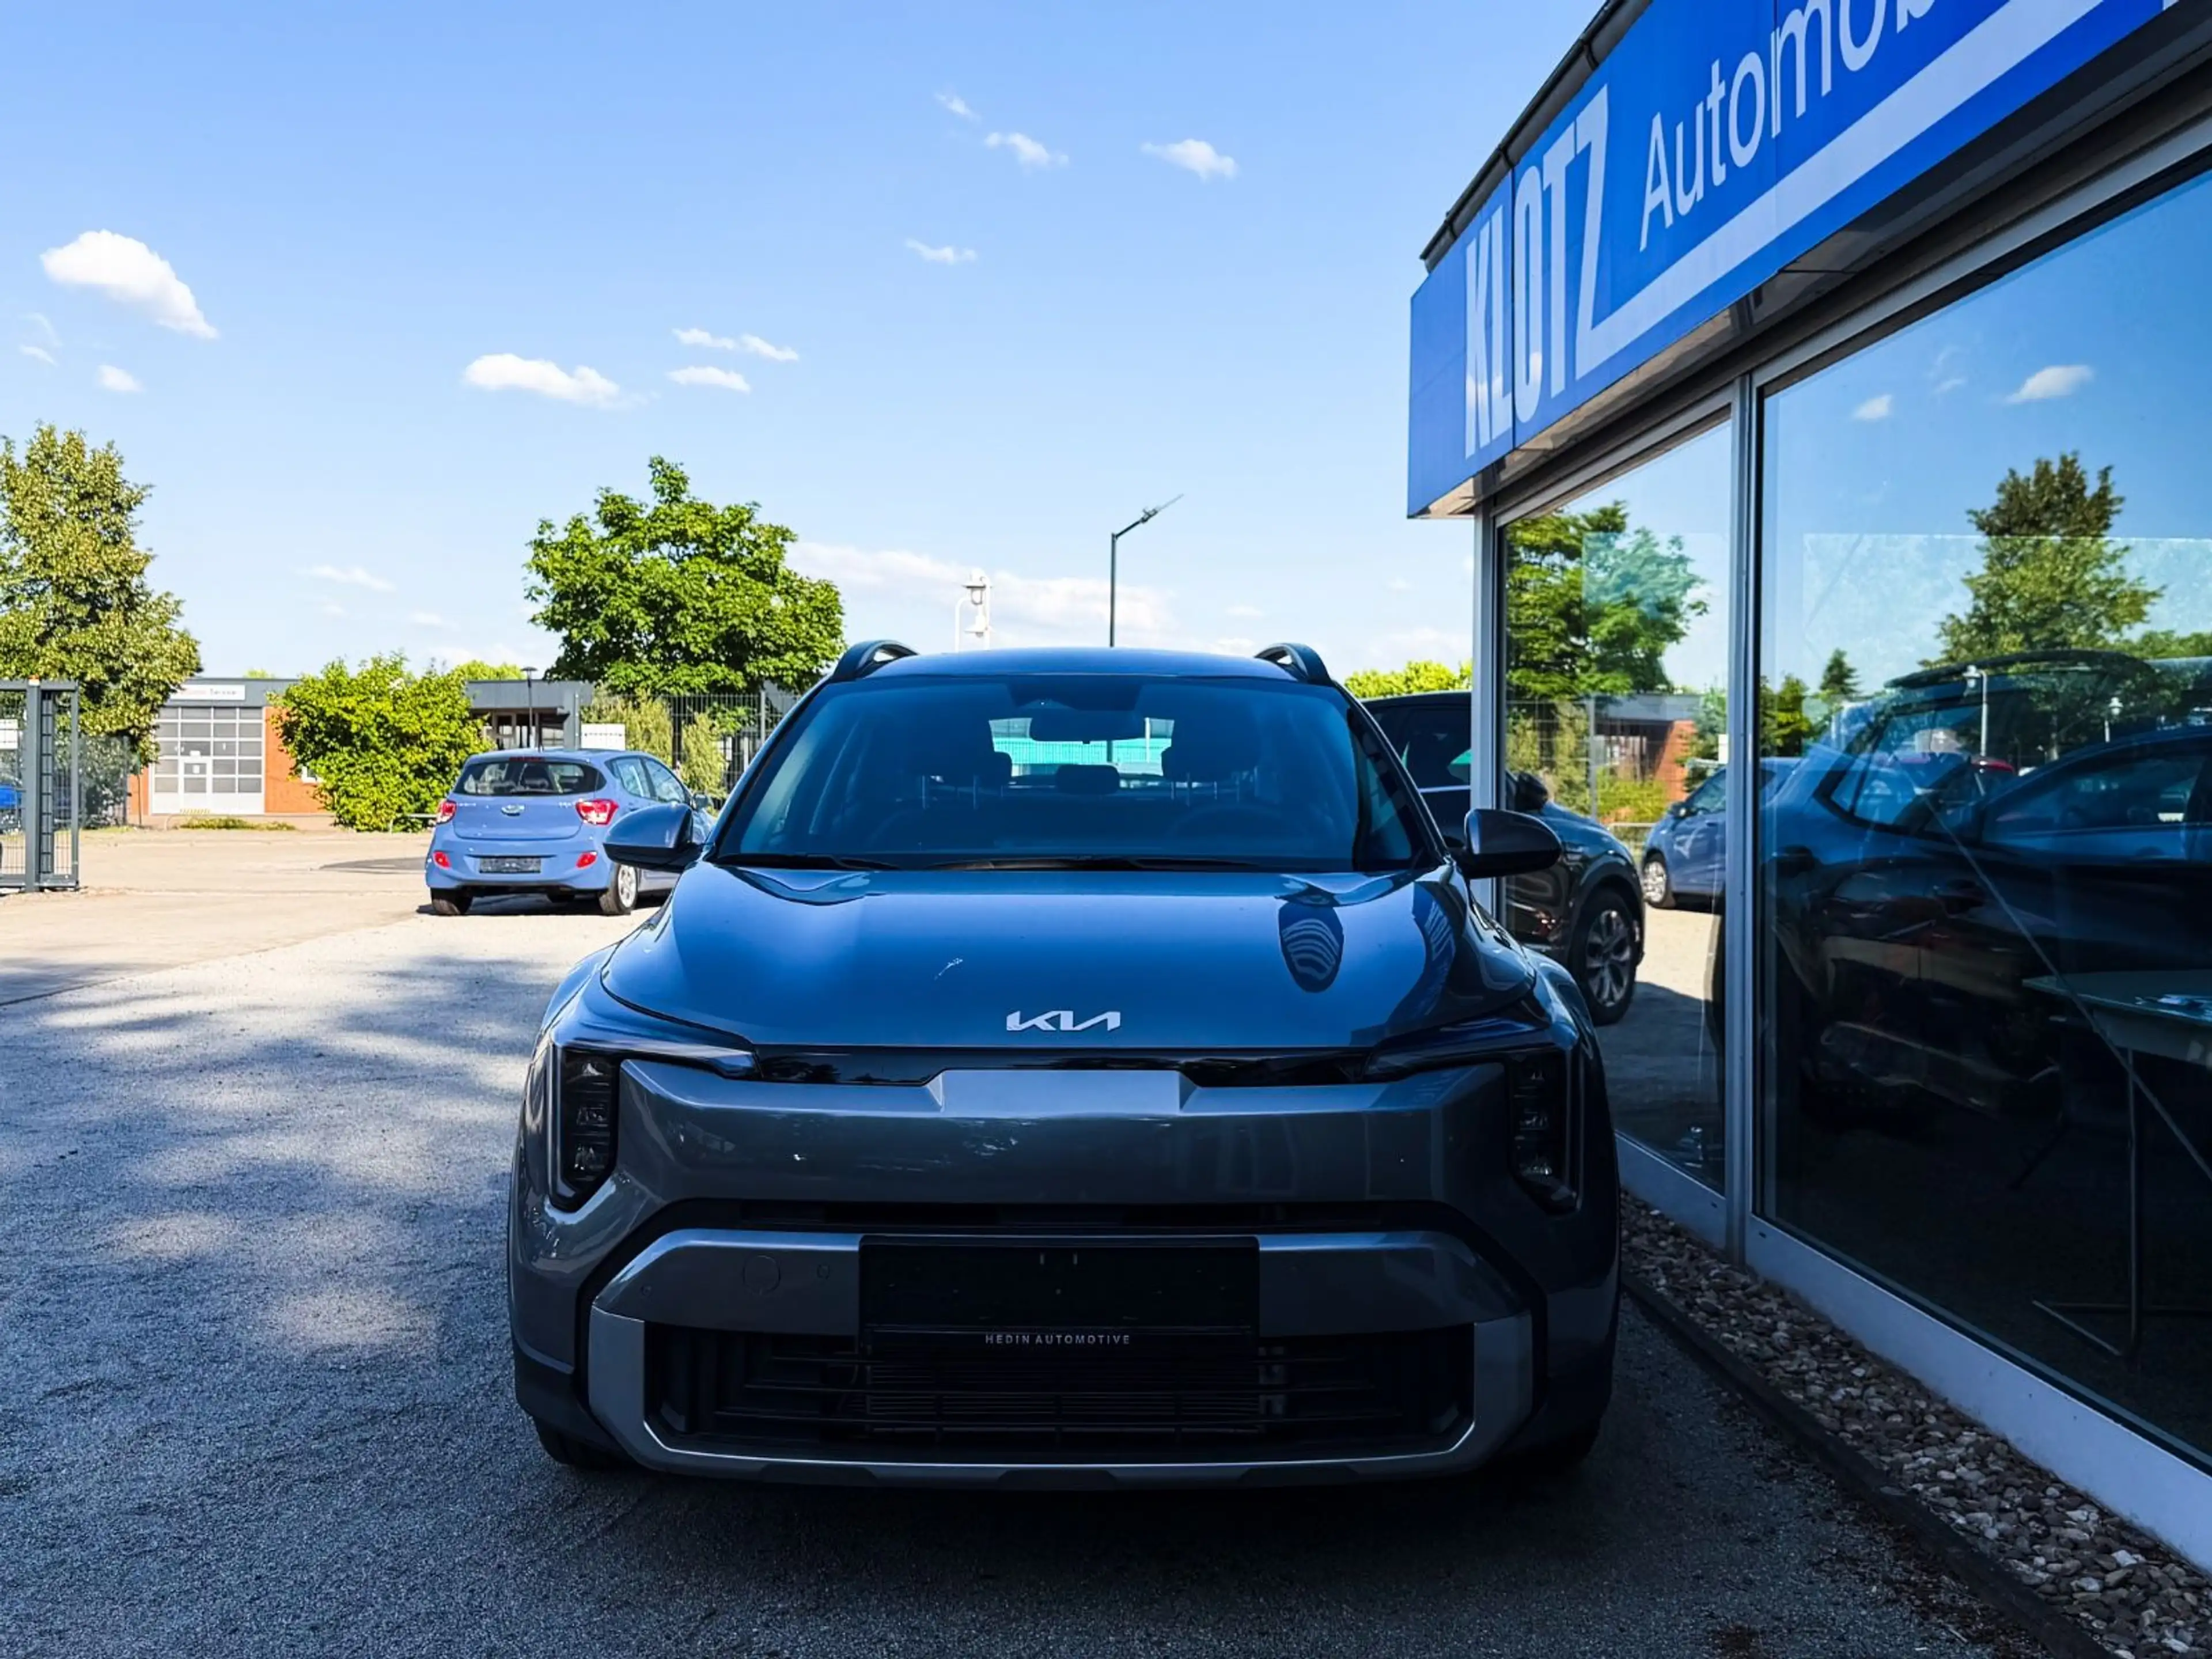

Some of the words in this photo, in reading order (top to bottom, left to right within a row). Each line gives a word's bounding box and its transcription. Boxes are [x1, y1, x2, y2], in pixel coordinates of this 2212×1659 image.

[1465, 83, 1609, 460] KLOTZ
[1639, 0, 1935, 252] Automo
[985, 1334, 1029, 1344] HEDIN
[1036, 1334, 1130, 1345] AUTOMOTIVE
